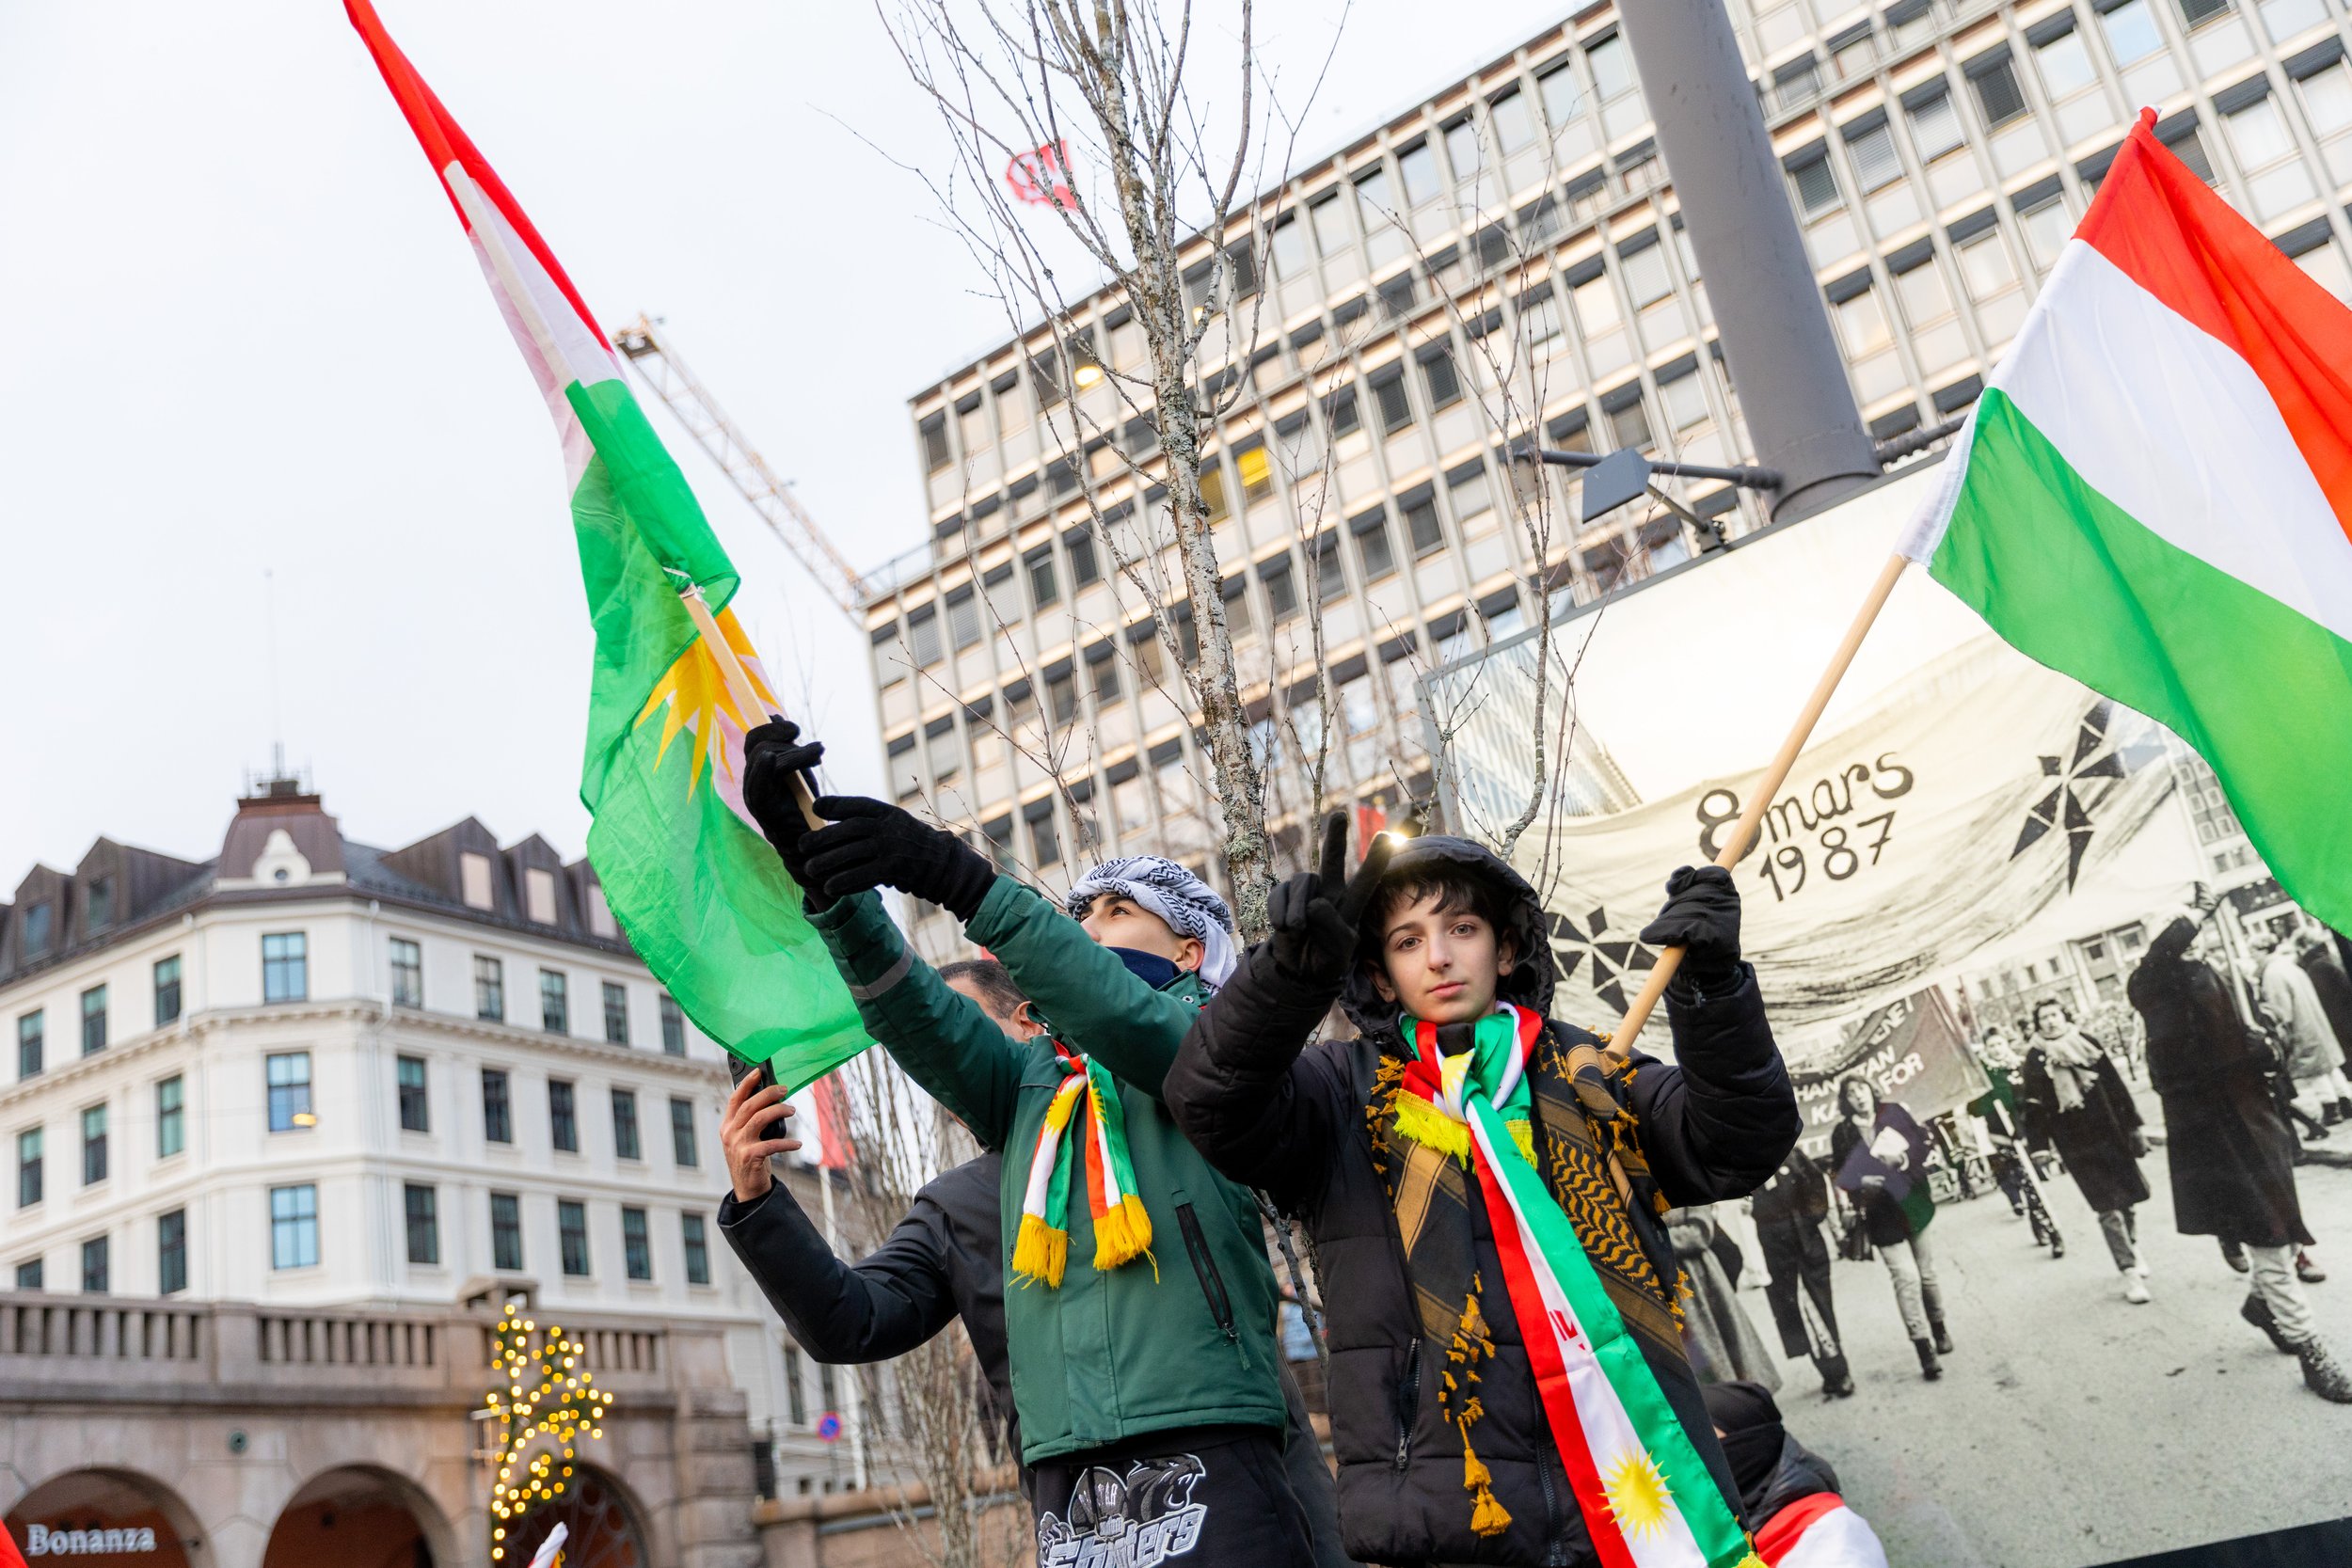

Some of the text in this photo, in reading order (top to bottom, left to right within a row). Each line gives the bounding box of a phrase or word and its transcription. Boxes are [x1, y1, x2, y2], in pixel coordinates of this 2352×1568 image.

[1696, 752, 1914, 863] 8 mars
[1759, 810, 1897, 902] 1987
[1878, 1052, 1925, 1096] FOR
[26, 1524, 157, 1556] Bonanza
